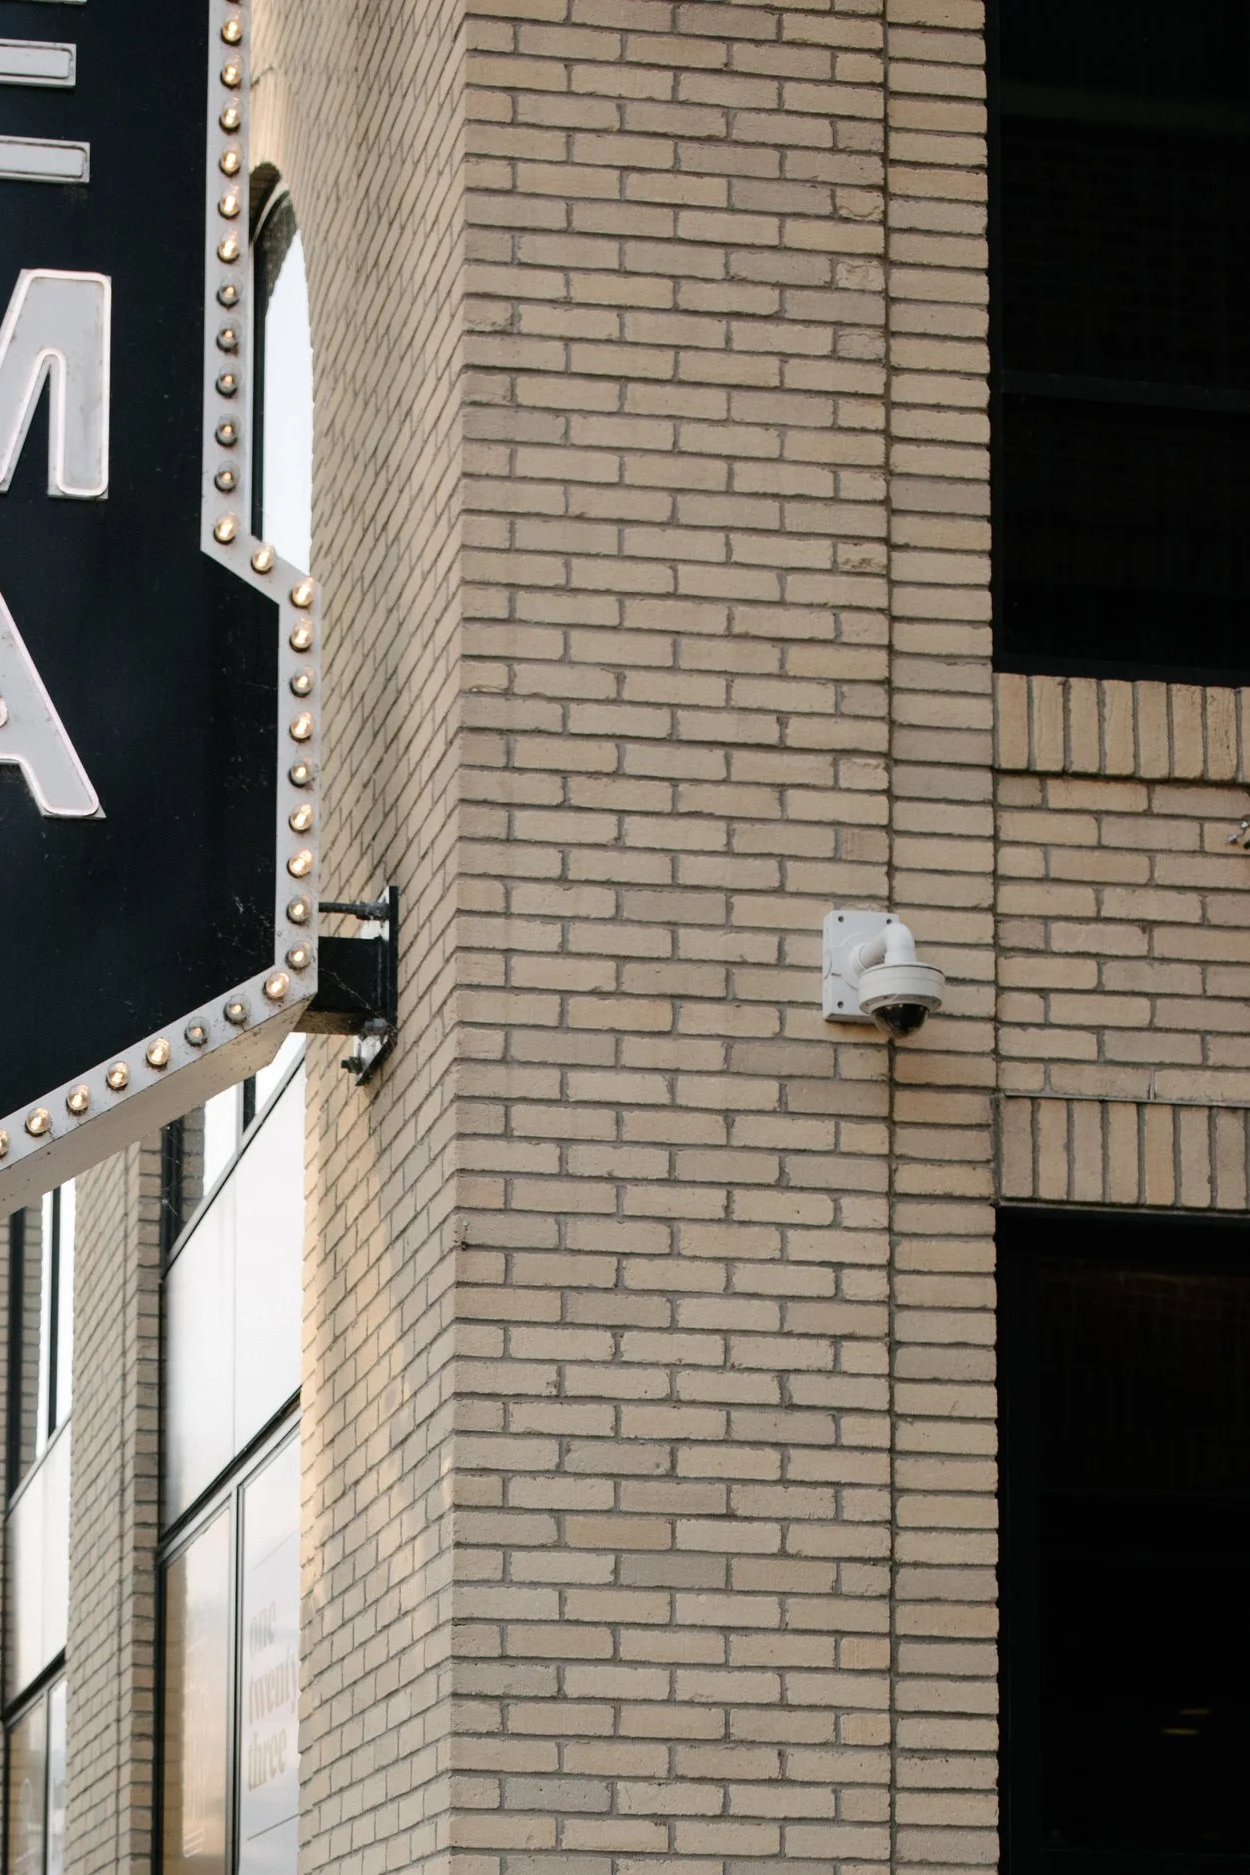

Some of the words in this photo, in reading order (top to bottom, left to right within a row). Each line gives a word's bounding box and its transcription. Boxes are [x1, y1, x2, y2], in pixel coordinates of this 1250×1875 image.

[249, 1600, 276, 1658] one
[248, 1645, 297, 1726] twenty
[247, 1726, 287, 1793] three
